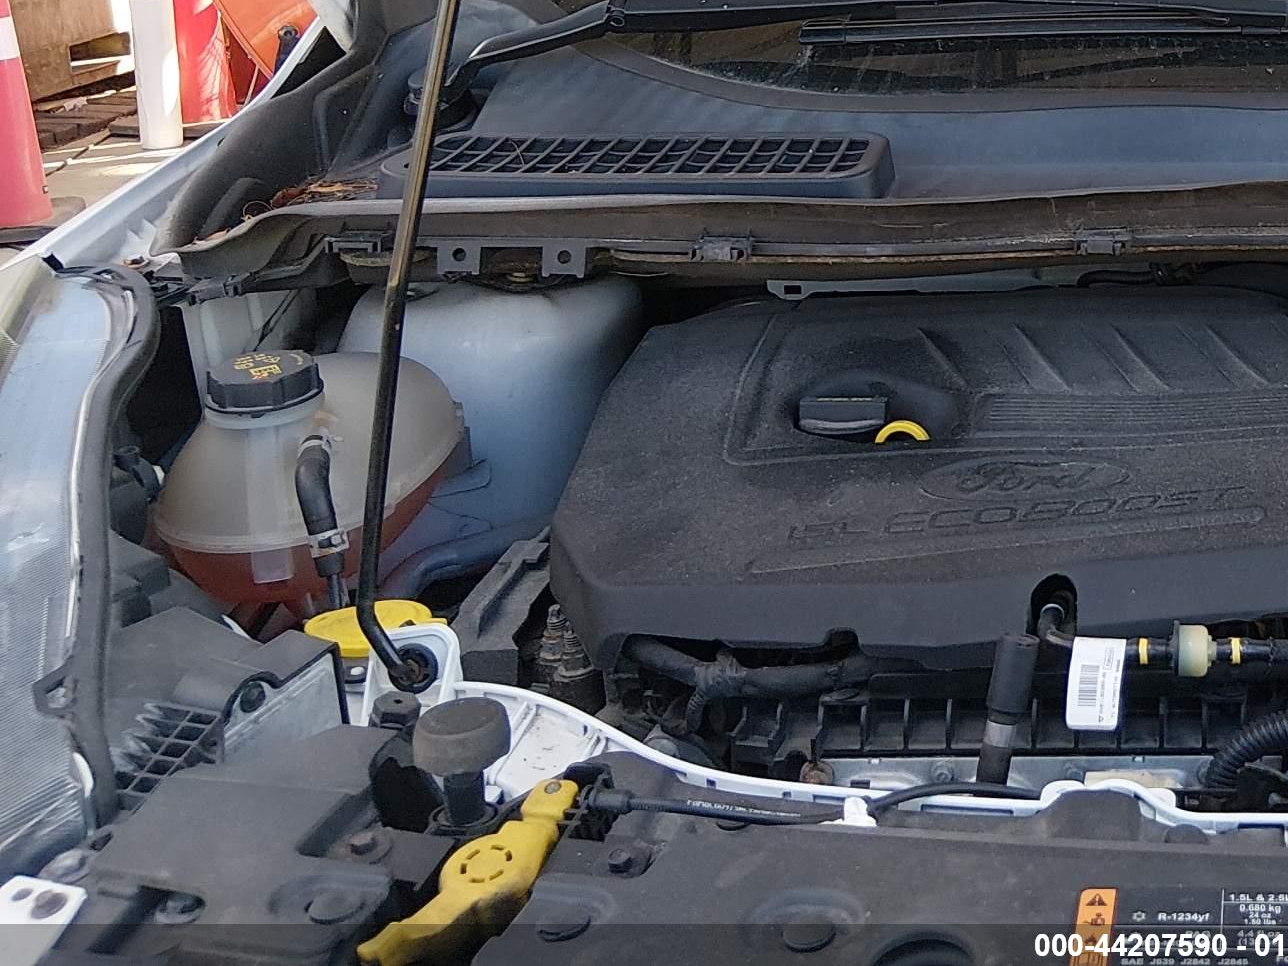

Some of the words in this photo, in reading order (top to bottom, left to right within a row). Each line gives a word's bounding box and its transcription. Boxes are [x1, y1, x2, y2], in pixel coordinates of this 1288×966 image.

[956, 461, 1096, 492] Ford
[884, 486, 1248, 534] ECOBOOST
[1239, 903, 1267, 913] 0.680
[1268, 903, 1282, 914] kg
[1157, 911, 1210, 922] R-1234yf
[1120, 958, 1144, 966] SAE
